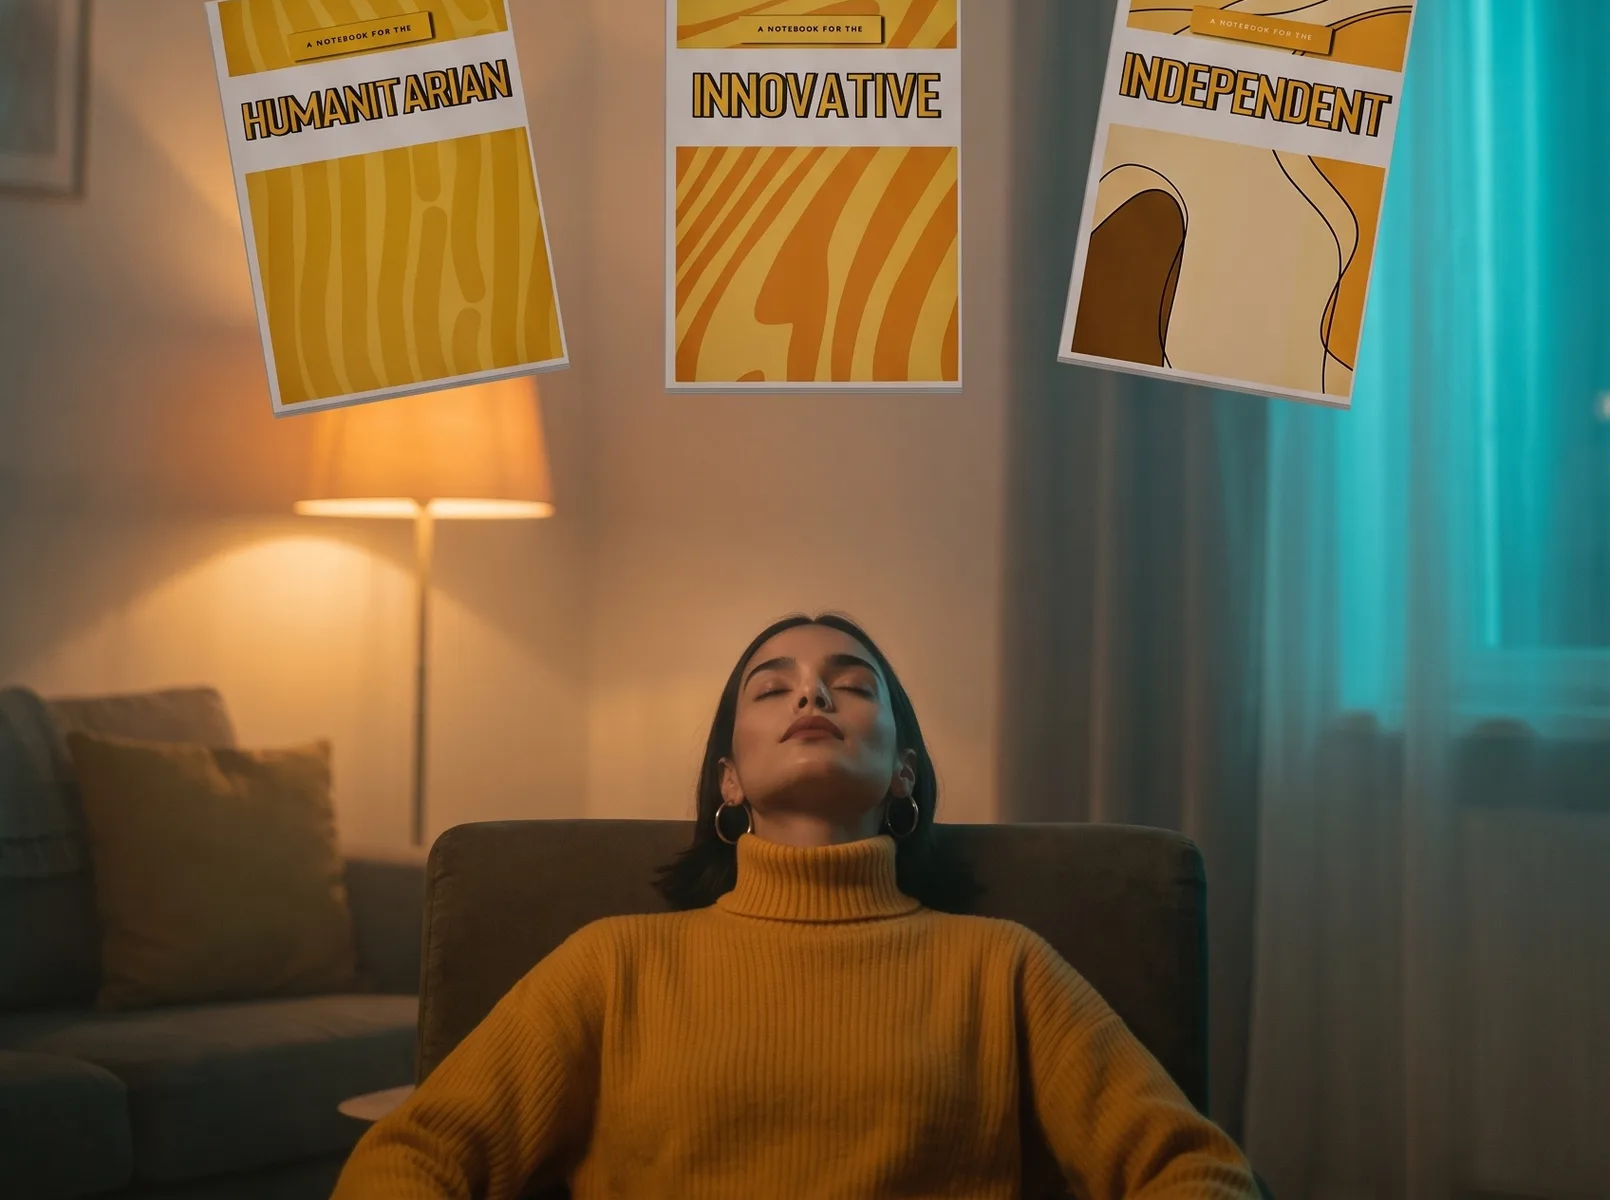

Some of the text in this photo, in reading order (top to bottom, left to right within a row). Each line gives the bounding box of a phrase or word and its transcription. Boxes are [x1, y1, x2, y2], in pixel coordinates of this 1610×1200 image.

[316, 31, 369, 47] NOTEBOOK
[371, 27, 391, 38] FOR
[393, 24, 413, 34] THE
[757, 25, 863, 33] A NOTEBOOK FOR THE
[1272, 28, 1292, 39] FOR
[1295, 32, 1313, 42] THE
[241, 58, 513, 141] HUMANITARIAN
[692, 72, 942, 119] INNOVATIVE
[1118, 51, 1393, 137] INDEPENDENT
